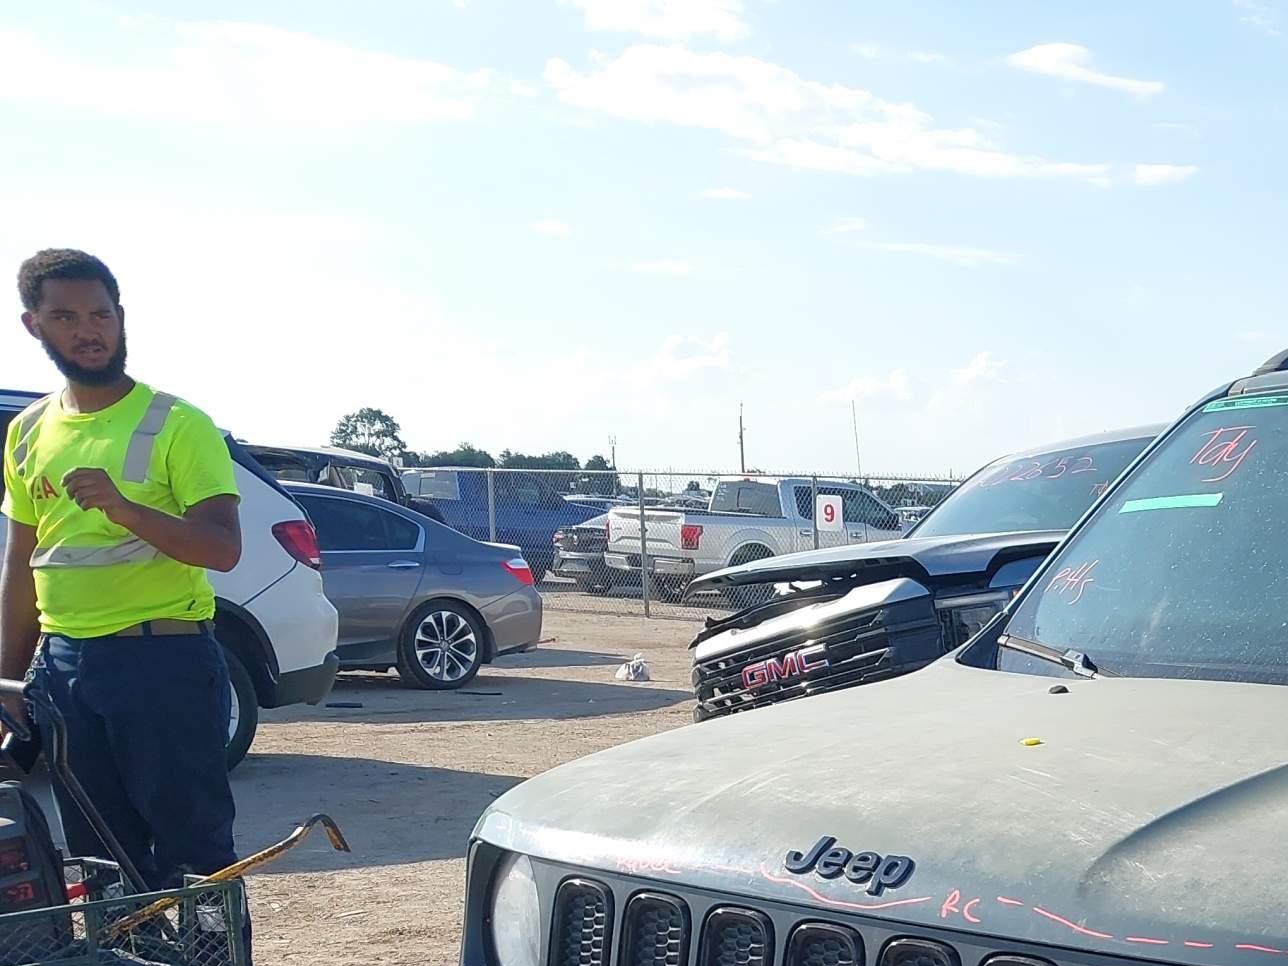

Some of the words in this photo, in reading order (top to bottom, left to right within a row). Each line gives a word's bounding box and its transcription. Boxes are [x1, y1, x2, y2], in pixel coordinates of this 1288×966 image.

[823, 503, 836, 524] 9
[740, 645, 832, 690] GMC
[785, 836, 916, 897] Jeep
